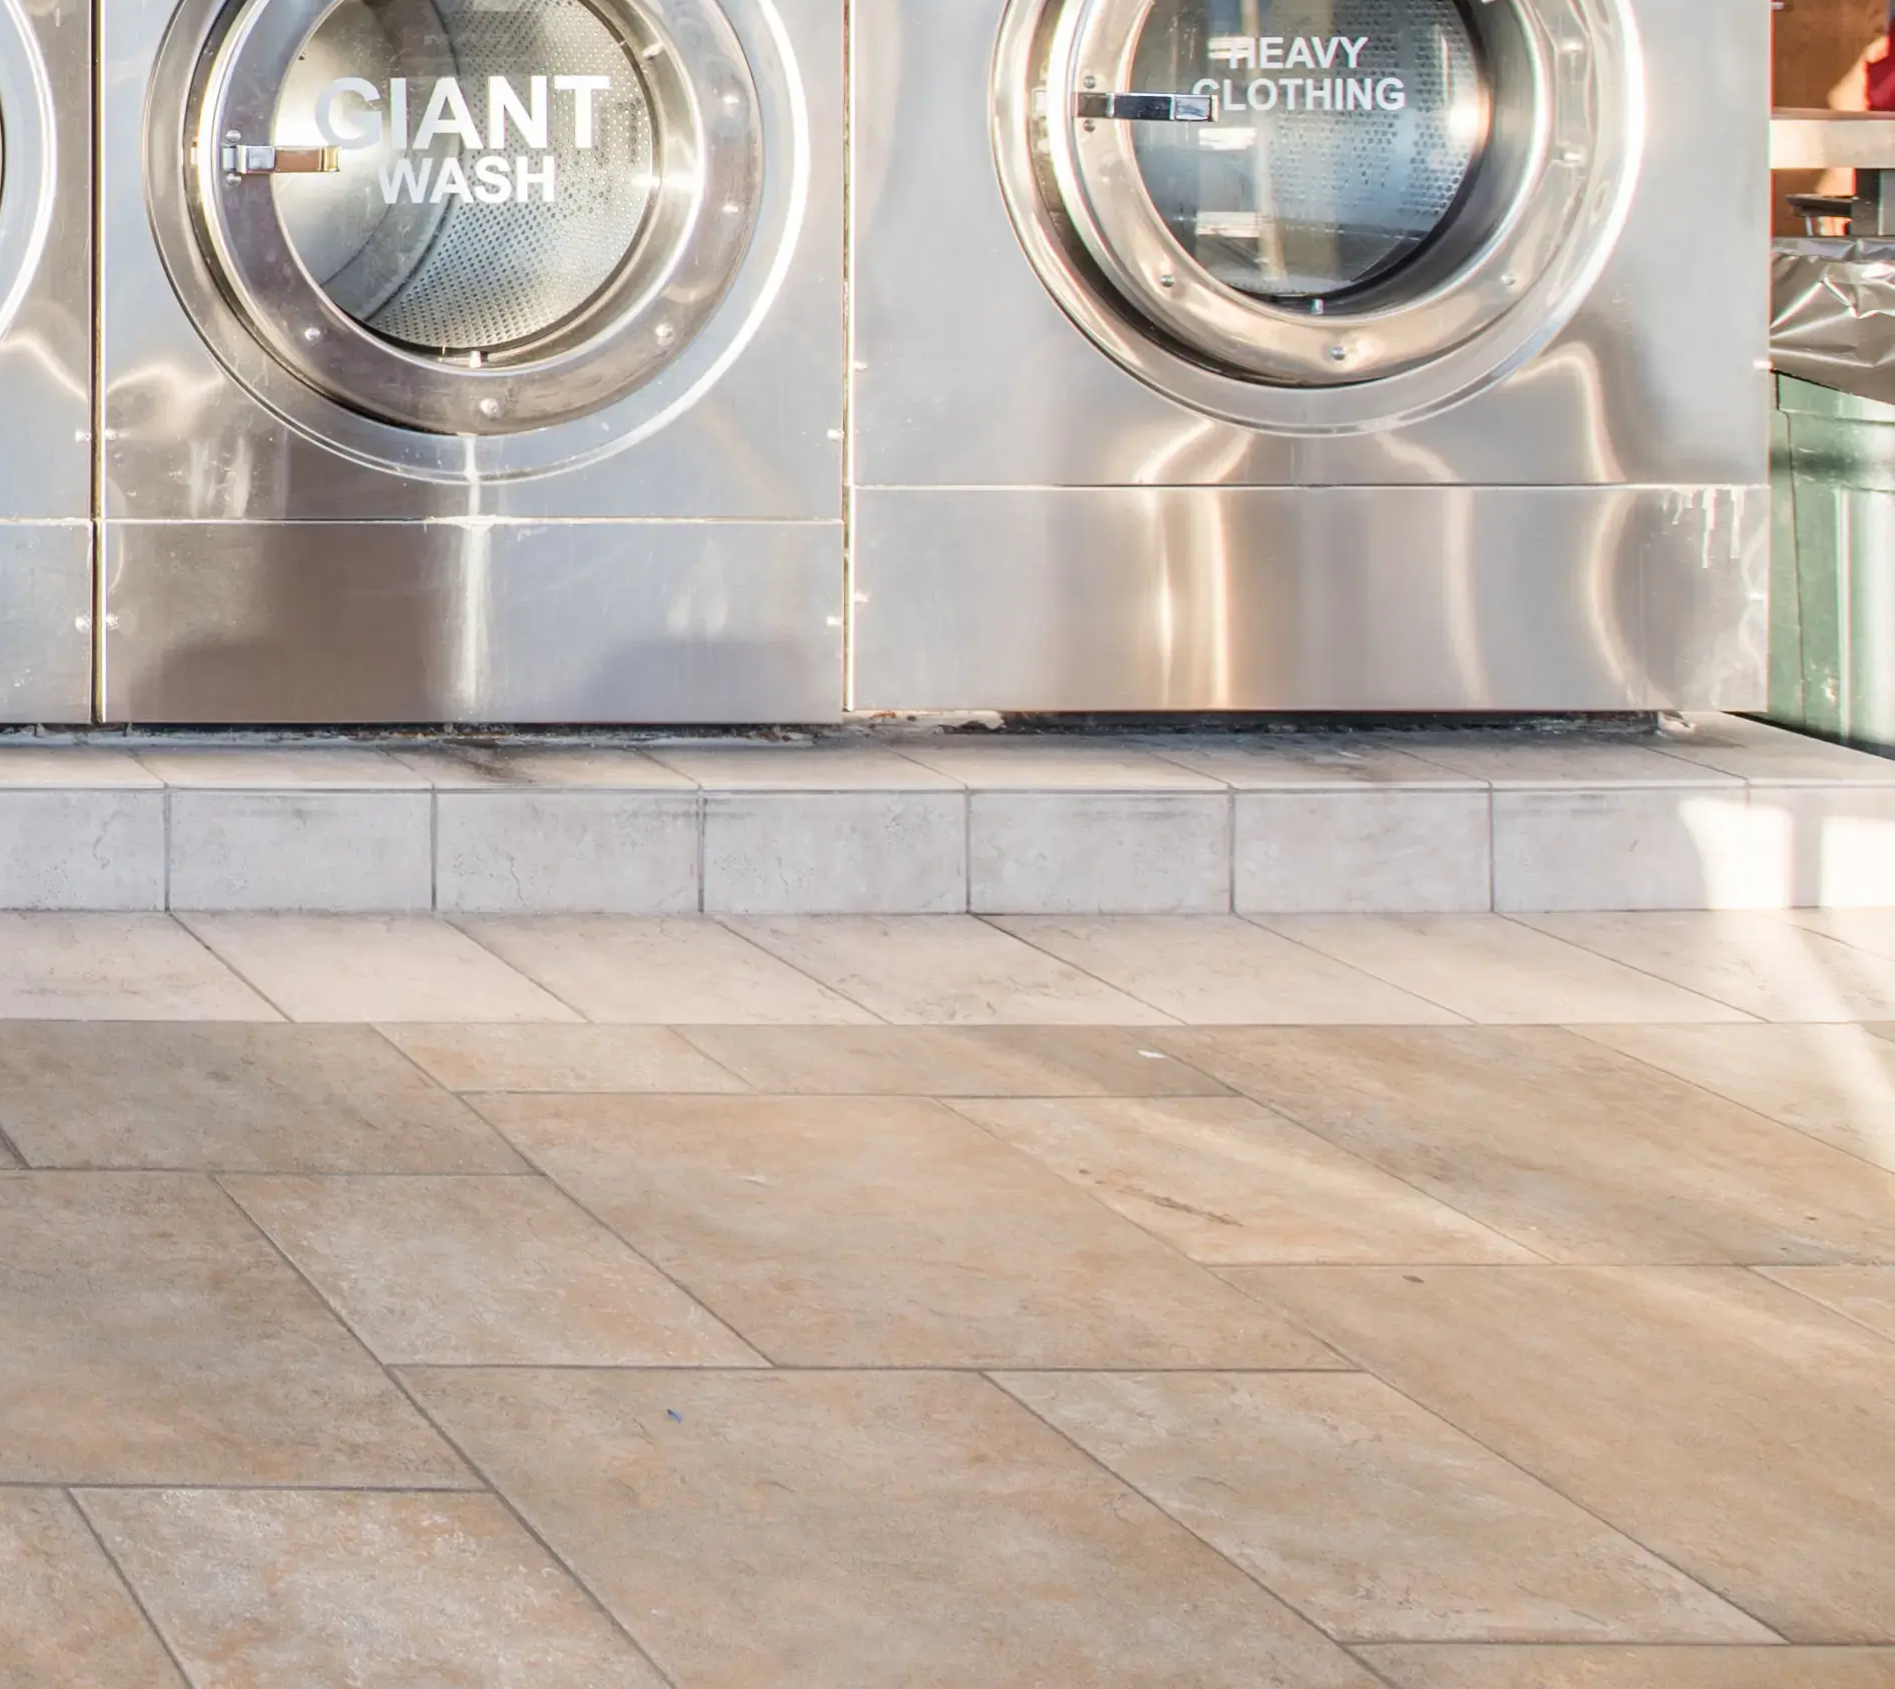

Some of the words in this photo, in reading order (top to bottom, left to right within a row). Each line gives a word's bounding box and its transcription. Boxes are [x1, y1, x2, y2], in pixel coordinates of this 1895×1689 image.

[1229, 36, 1369, 69] HEAVY
[315, 75, 613, 150] GIANT
[377, 155, 556, 204] WASH
